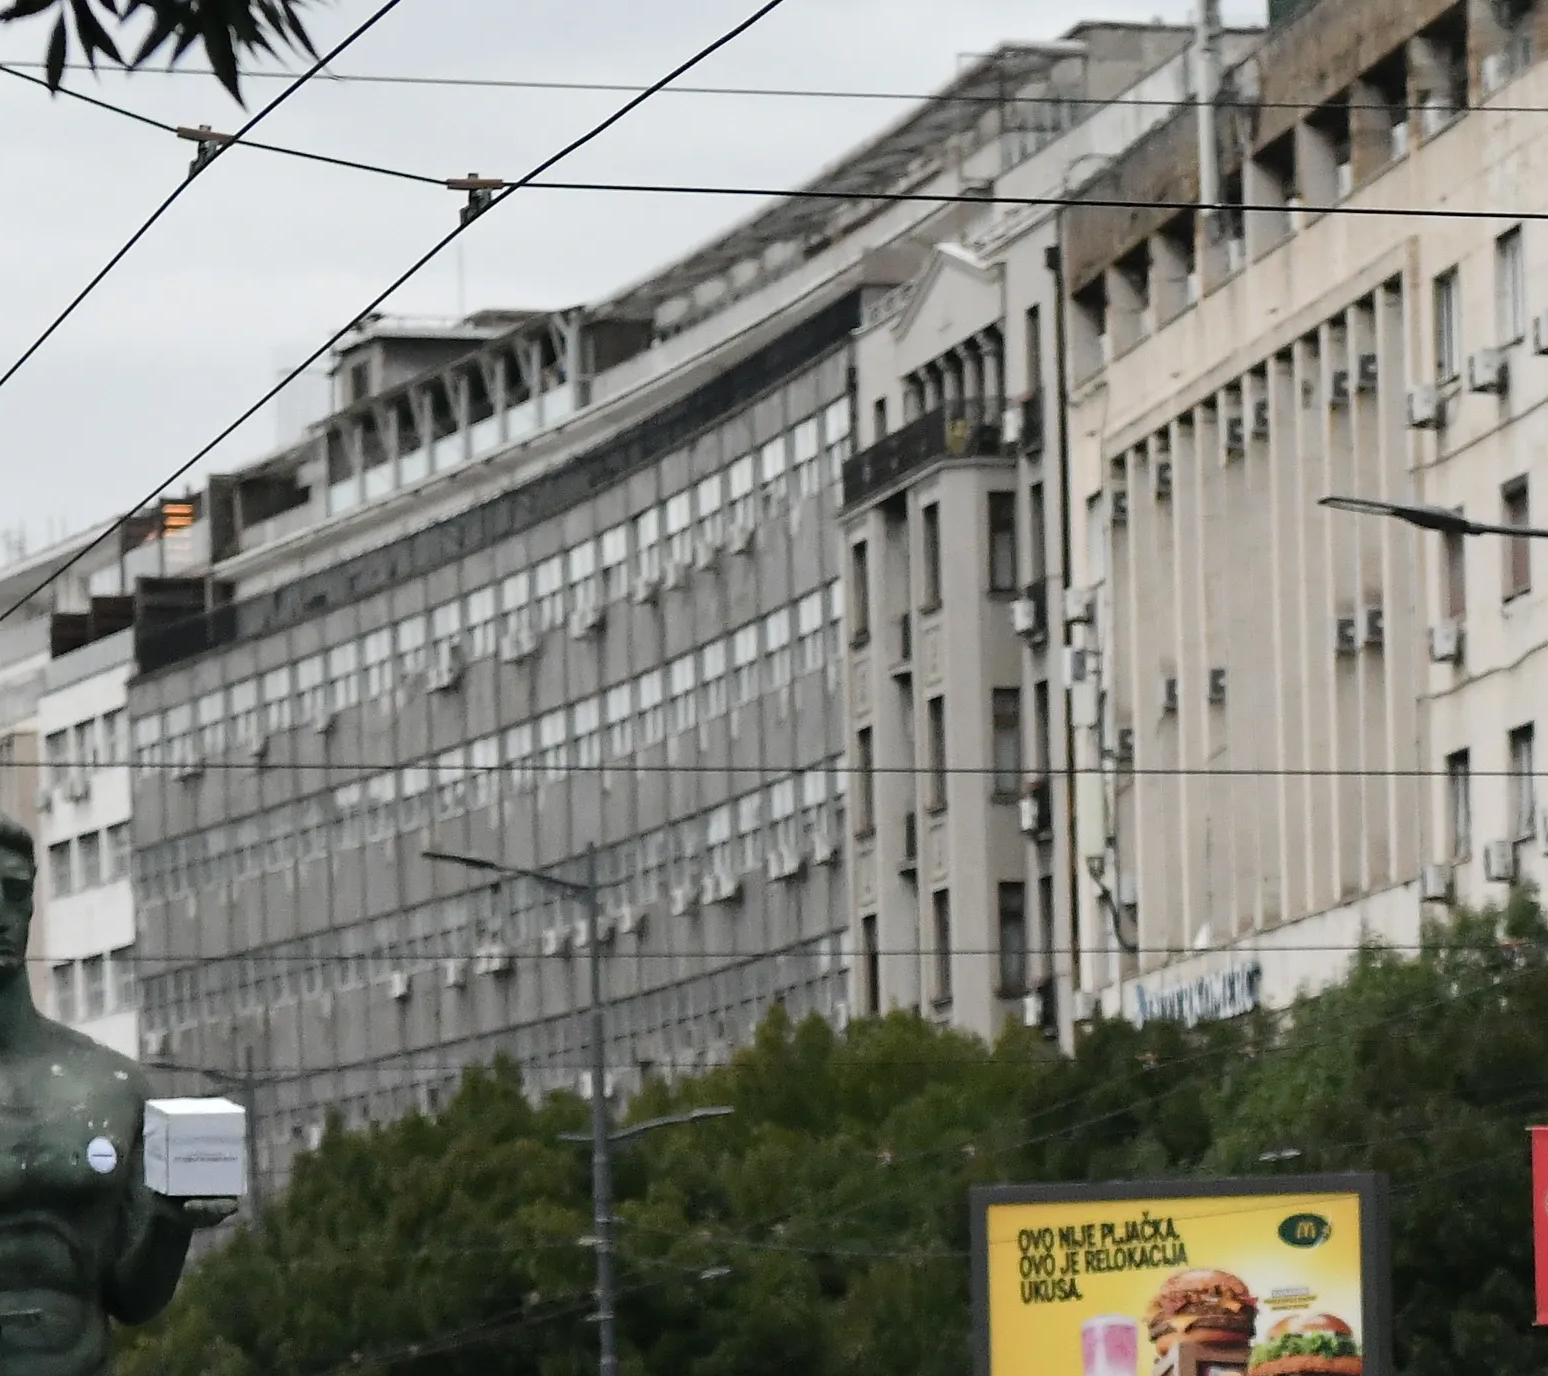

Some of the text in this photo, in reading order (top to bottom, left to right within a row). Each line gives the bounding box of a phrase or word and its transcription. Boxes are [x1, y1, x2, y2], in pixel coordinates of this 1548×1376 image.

[1018, 1227, 1054, 1251] OVO
[1059, 1224, 1096, 1248] NIJE
[1019, 1242, 1188, 1278] OVO JE RELOKACIJA
